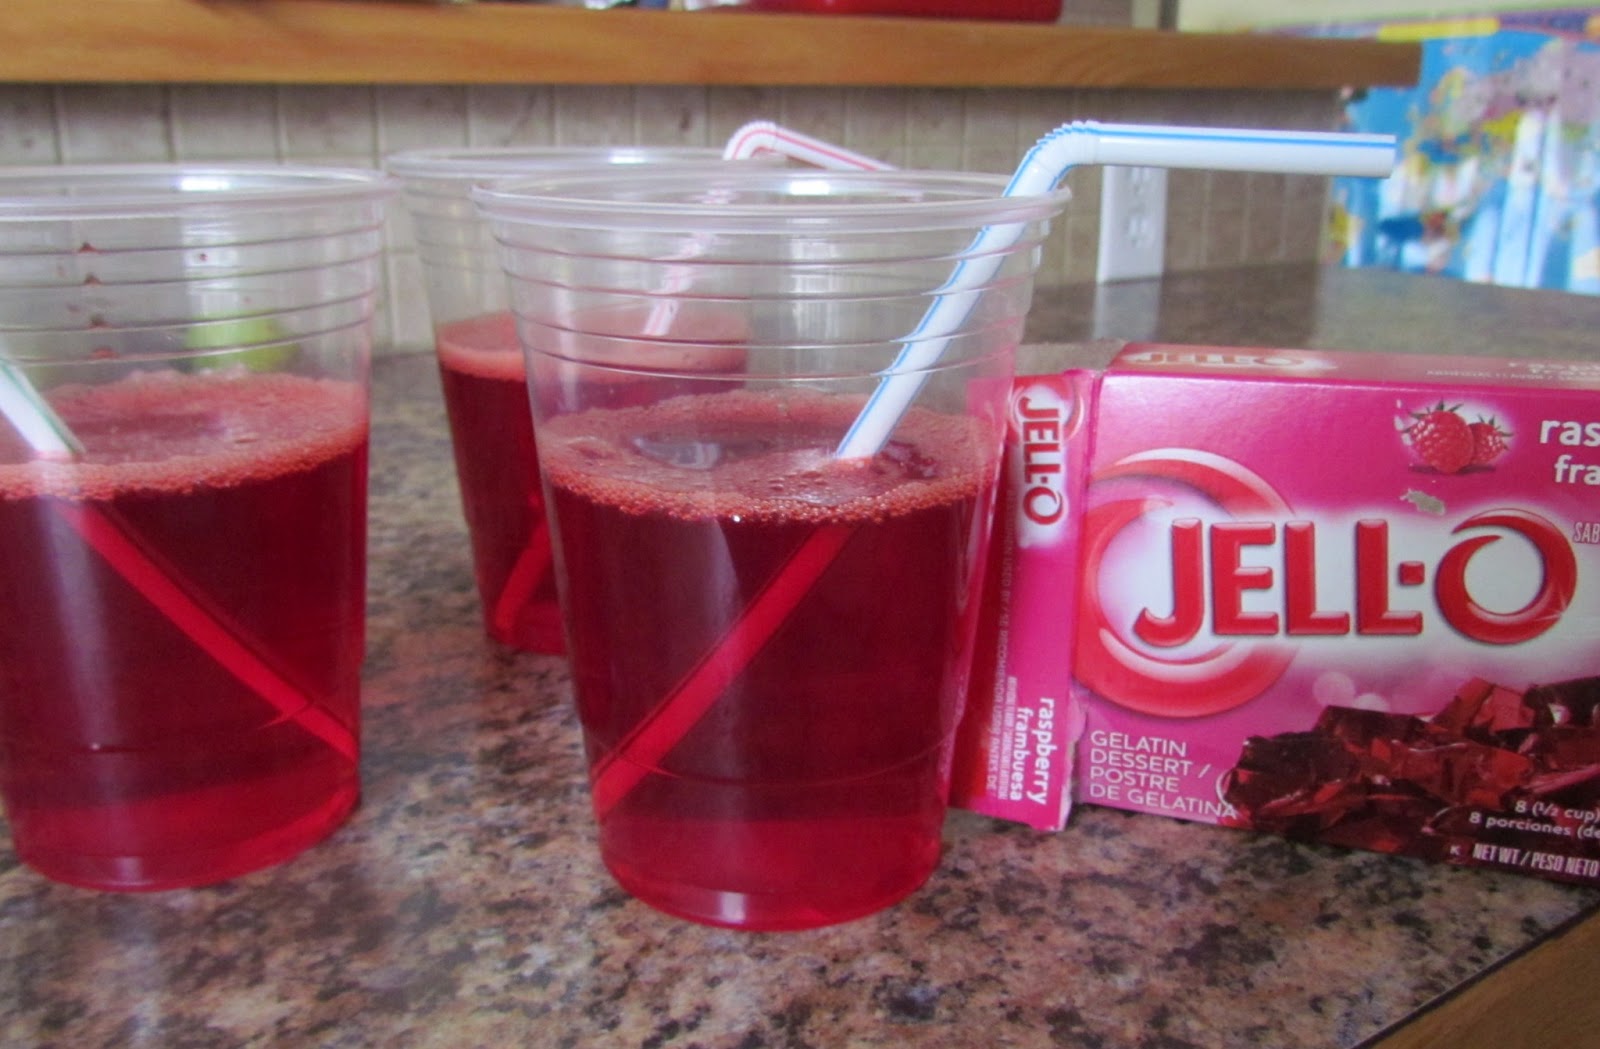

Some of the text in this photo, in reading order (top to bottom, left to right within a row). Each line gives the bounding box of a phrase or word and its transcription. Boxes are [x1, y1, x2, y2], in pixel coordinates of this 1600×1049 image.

[1540, 420, 1600, 447] ras
[1018, 396, 1063, 525] JELL-O
[1554, 454, 1600, 486] fra
[1133, 508, 1577, 647] JELL-O
[1010, 707, 1034, 801] frambuesa
[1026, 698, 1057, 805] raspberry
[1090, 730, 1187, 757] GELATIN
[1090, 748, 1193, 776] DESSERT
[1090, 766, 1180, 793] POSTRE
[1090, 783, 1238, 820] DE GELATINA
[1515, 800, 1527, 813] 8
[1468, 811, 1481, 824] 8
[1485, 816, 1572, 836] porciones
[1472, 843, 1498, 861] NET
[1498, 847, 1521, 865] WT
[1530, 852, 1565, 872] PESO
[1565, 857, 1600, 878] NETO
